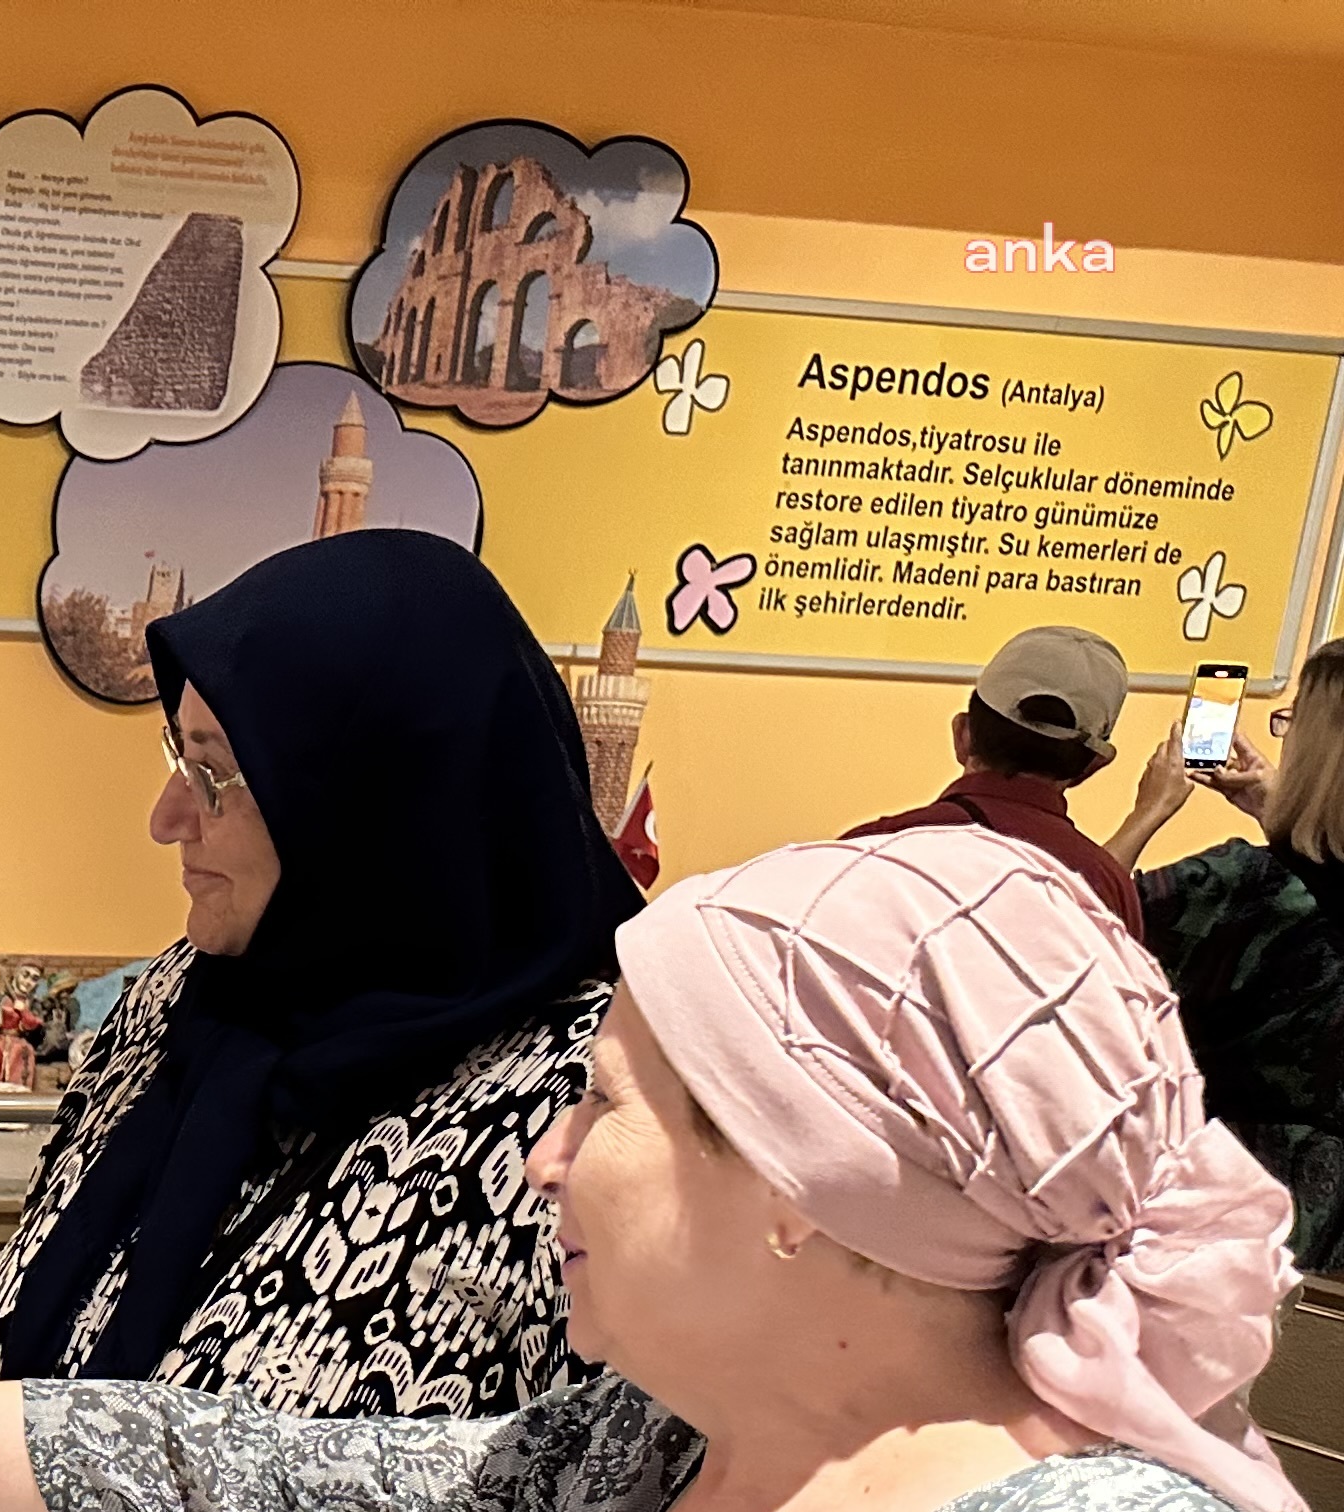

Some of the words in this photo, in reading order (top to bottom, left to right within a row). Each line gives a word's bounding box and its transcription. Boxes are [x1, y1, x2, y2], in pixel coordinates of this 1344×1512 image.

[797, 353, 990, 401] Aspendos
[1001, 378, 1105, 414] (Antalya)
[1034, 432, 1061, 456] ile
[782, 452, 954, 484] tanınmaktadır.
[963, 462, 1098, 494] Selçuklular
[1104, 471, 1235, 501] döneminde
[776, 488, 863, 513] restore
[870, 492, 943, 518] edilen
[951, 496, 1028, 526] tiyatro
[1034, 501, 1159, 531] günümüze
[769, 521, 858, 551] sağlam
[866, 525, 989, 559] ulaşmıştır.
[998, 532, 1030, 557] Su
[1037, 535, 1148, 564] kemerleri
[1154, 541, 1182, 565] de
[764, 553, 883, 583] önemlidir.
[892, 560, 981, 588] Madeni
[985, 570, 1038, 594] para
[1045, 568, 1141, 596] bastıran
[759, 587, 787, 612] ilk
[794, 590, 967, 621] şehirlerdendir.
